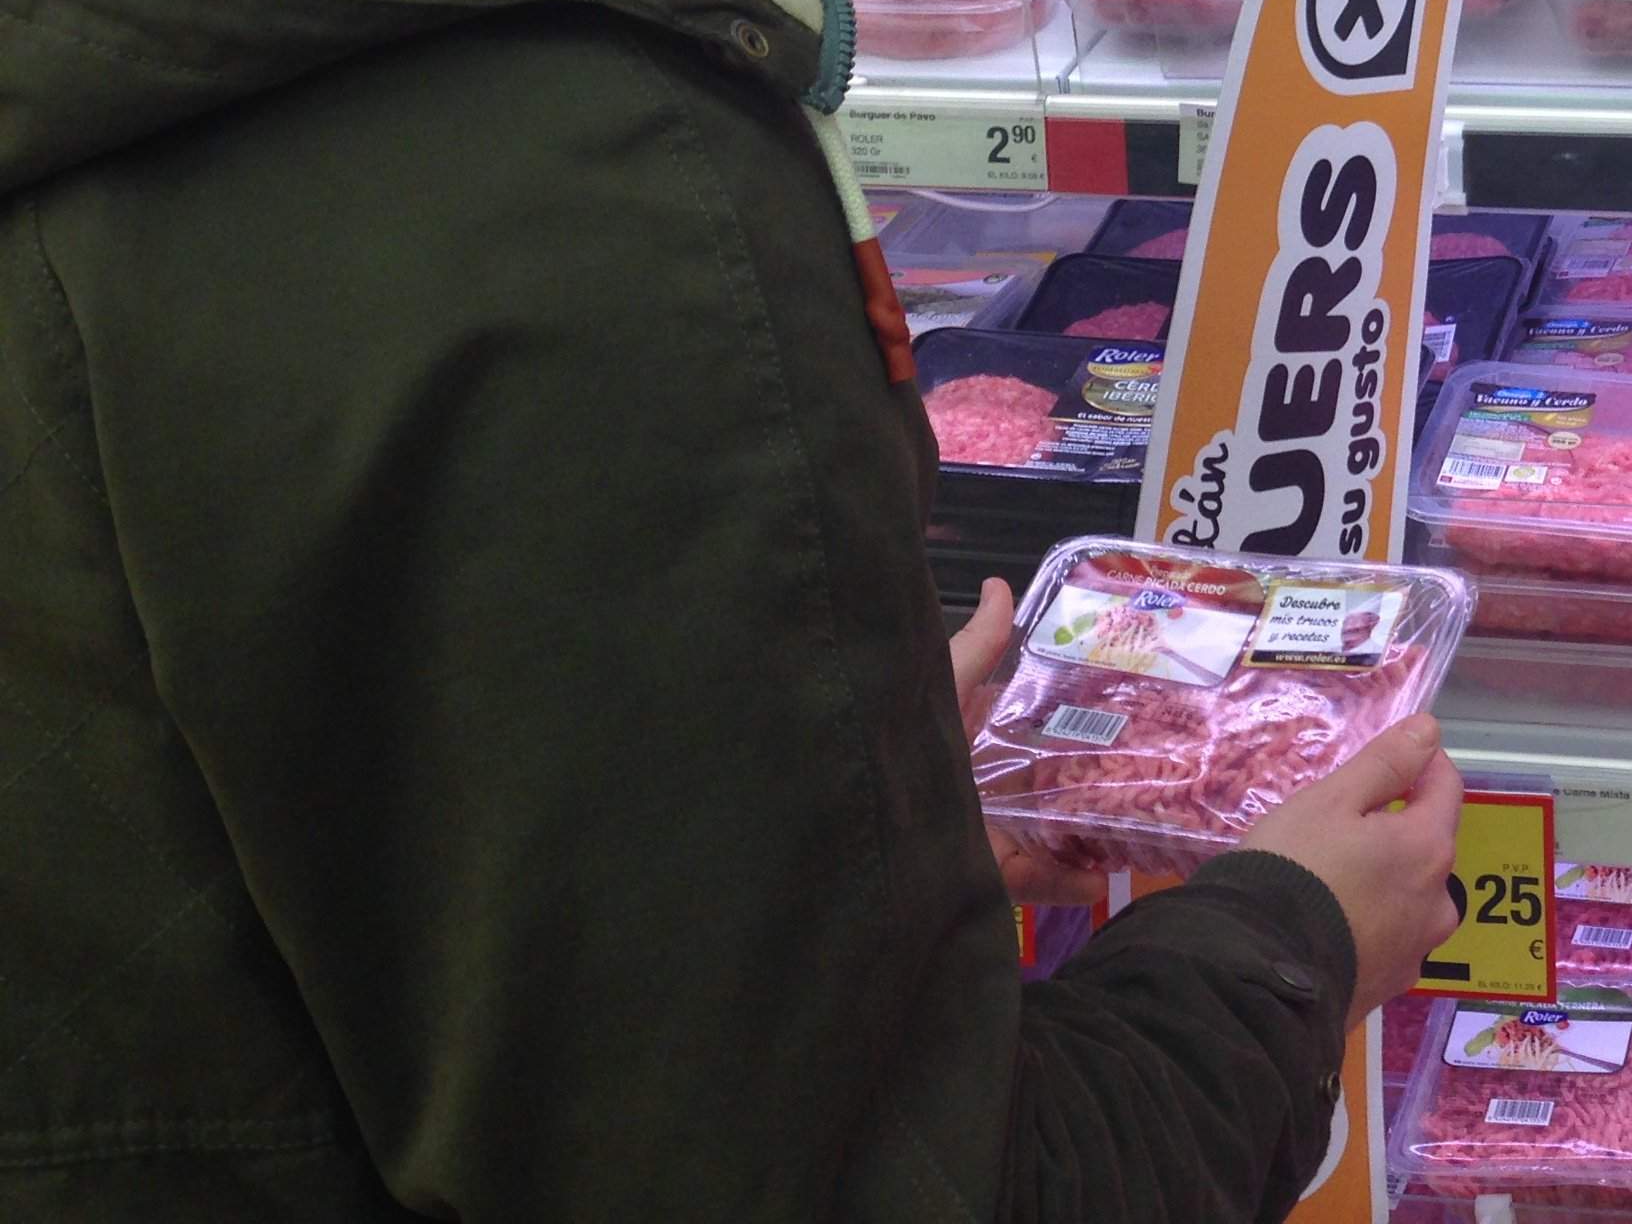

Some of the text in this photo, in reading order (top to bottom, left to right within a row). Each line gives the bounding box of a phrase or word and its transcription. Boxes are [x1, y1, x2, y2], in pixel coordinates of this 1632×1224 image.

[986, 124, 1036, 164] 2 90
[1094, 347, 1161, 363] Roler
[1339, 308, 1384, 556] su gusto
[1279, 595, 1342, 611] Descubre
[1474, 874, 1543, 927] 25
[1523, 1010, 1563, 1024] Roler
